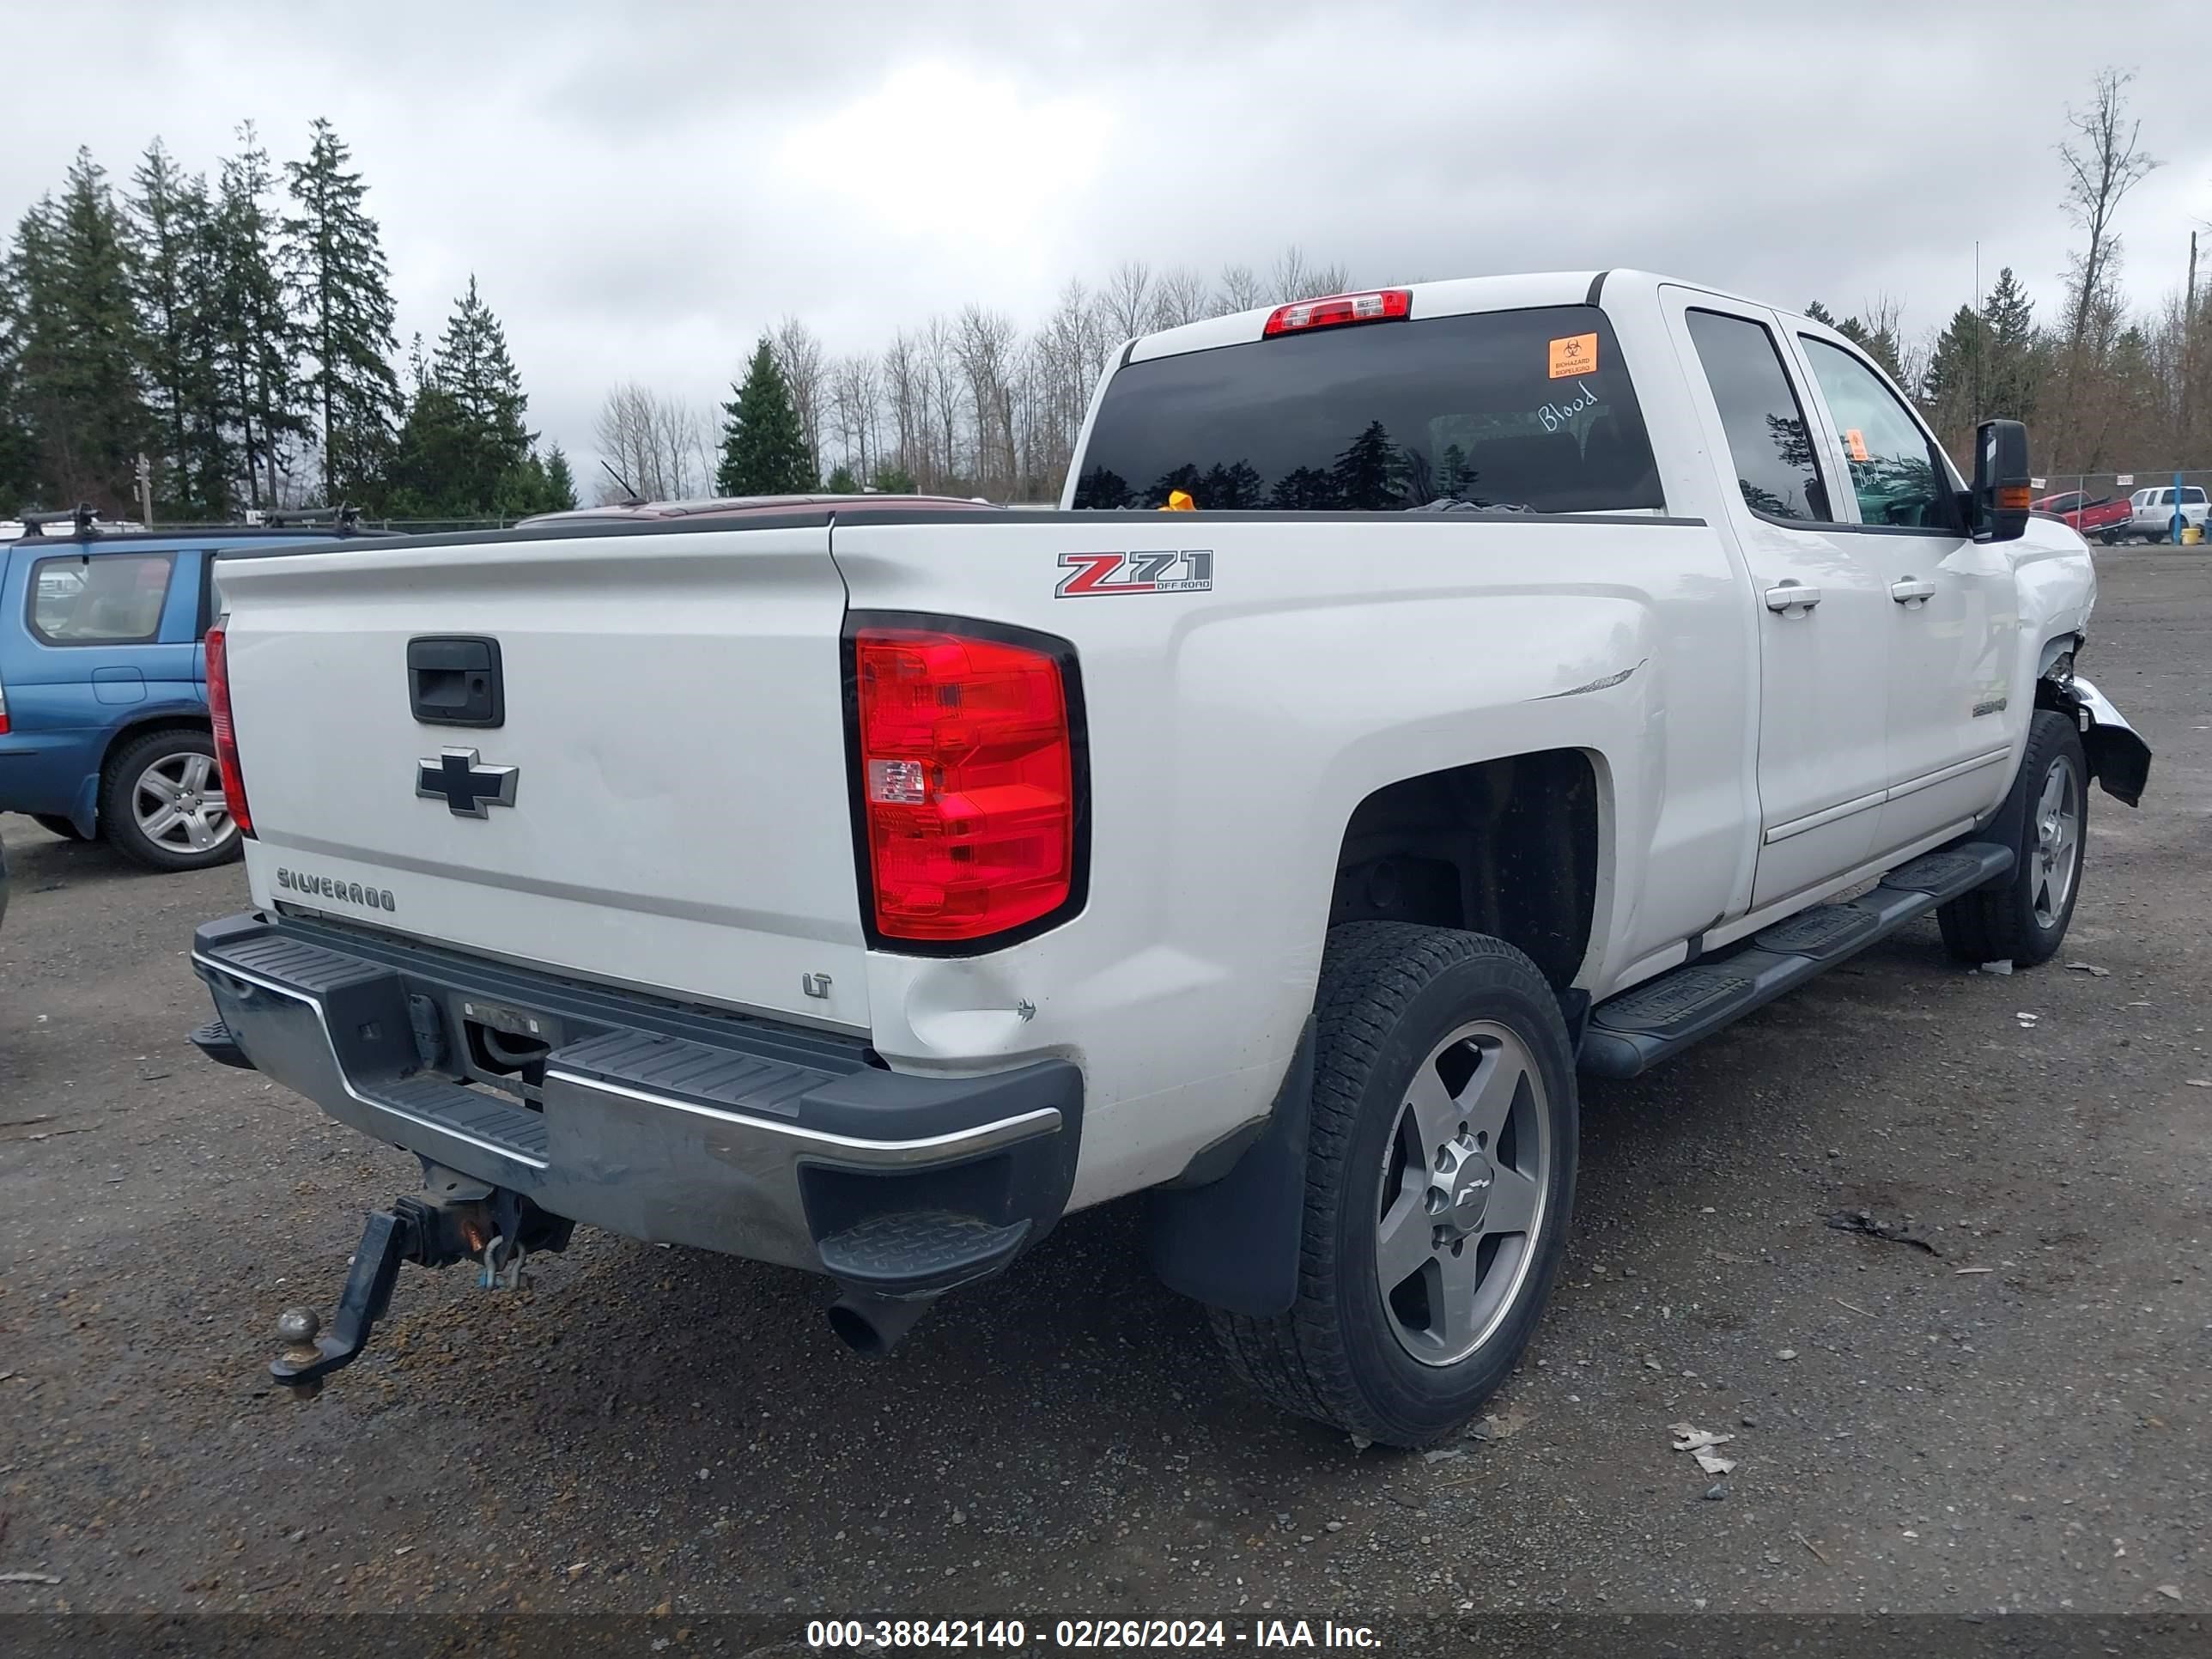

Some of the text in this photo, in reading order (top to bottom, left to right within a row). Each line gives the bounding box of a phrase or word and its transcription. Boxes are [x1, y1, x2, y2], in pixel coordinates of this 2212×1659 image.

[1555, 358, 1590, 369] BIOHAZARD
[1555, 366, 1590, 376] BIOPELIGRO
[1537, 380, 1598, 432] Blood
[1054, 550, 1213, 599] Z71
[1181, 580, 1210, 589] ROAD
[276, 866, 396, 912] SILVERADO
[802, 972, 832, 999] LT
